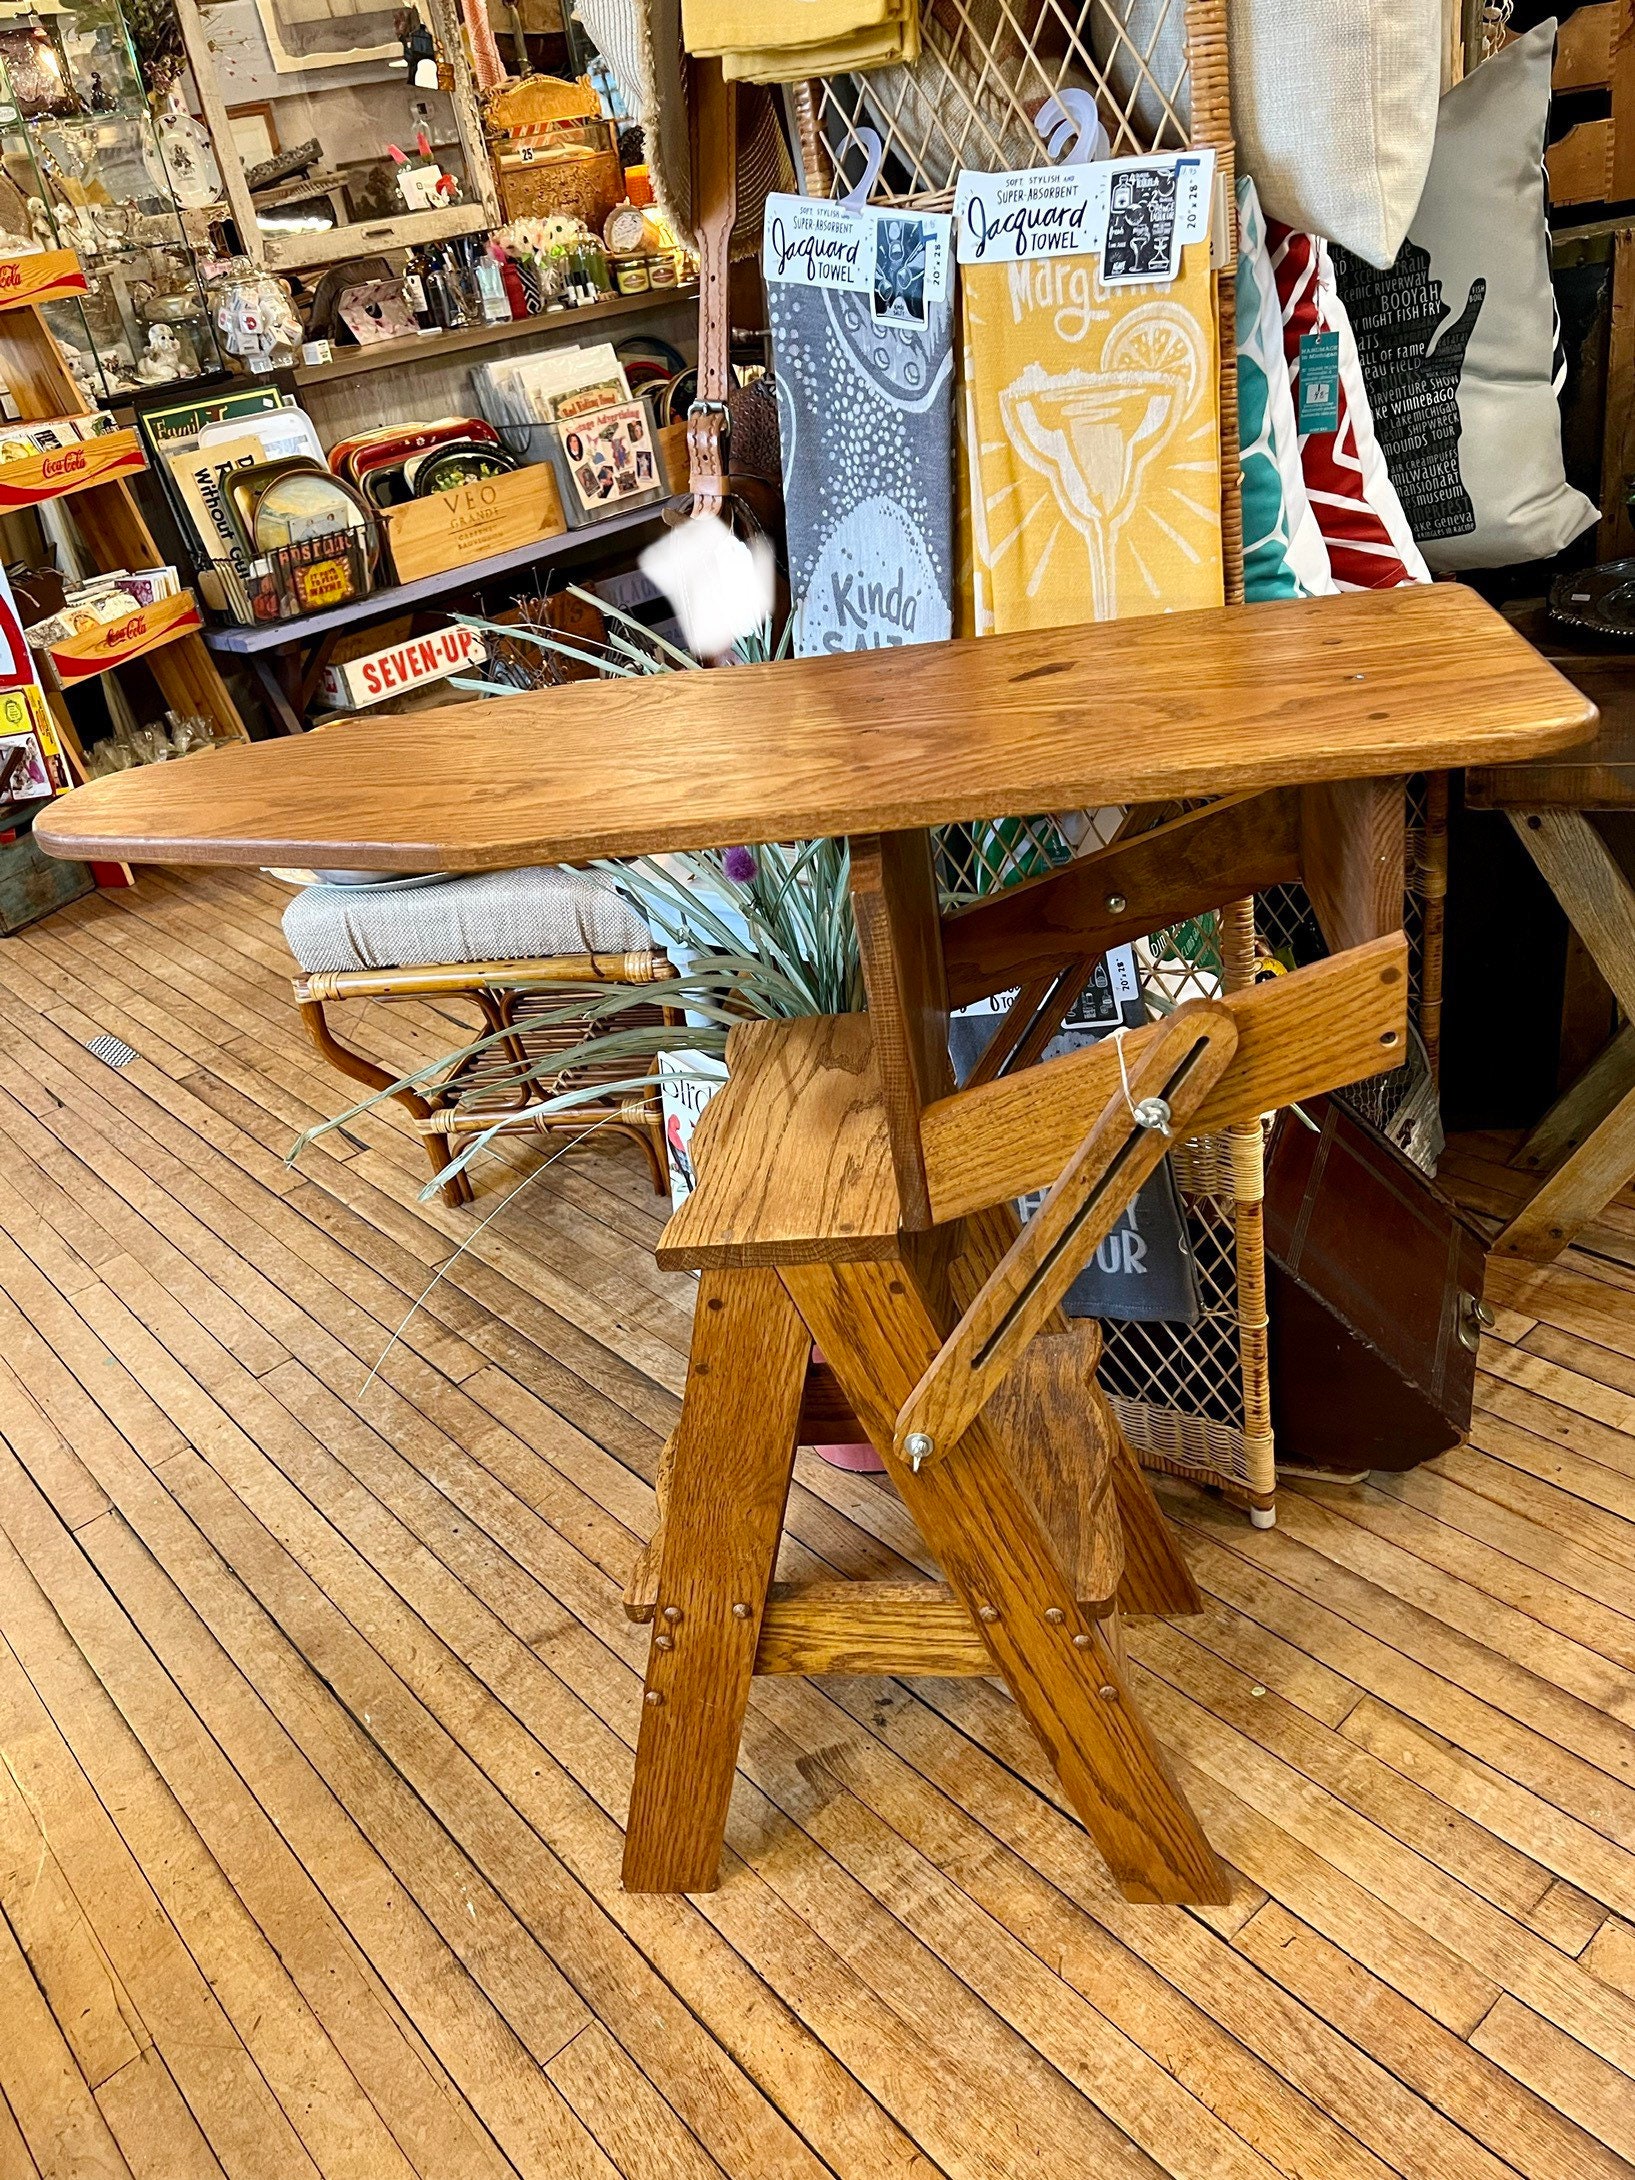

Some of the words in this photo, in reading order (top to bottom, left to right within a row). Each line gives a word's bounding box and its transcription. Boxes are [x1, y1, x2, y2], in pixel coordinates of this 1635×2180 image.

[522, 148, 533, 161] 25
[1029, 175, 1060, 185] STYLISH
[997, 185, 1079, 205] SUPER-ABSORBENT
[817, 206, 840, 219] STYLISH
[793, 216, 853, 234] SUPER-ABSORBENT
[967, 196, 1088, 258] Jacquard
[772, 217, 860, 281] Jacquard
[1031, 231, 1079, 252] TOWEL
[818, 262, 854, 283] TOWEL
[1396, 306, 1420, 323] FISH
[1423, 300, 1441, 316] FRY
[1380, 349, 1393, 362] OF
[1430, 375, 1459, 391] SHOW
[156, 410, 200, 439] Famil
[1431, 425, 1456, 441] TOUR
[42, 449, 87, 481] Coca-Cola
[194, 467, 235, 540] Without
[444, 485, 497, 514] VEO
[450, 507, 501, 529] GRANDE
[309, 580, 342, 597] WAYNE
[831, 566, 917, 634] Kinda
[105, 614, 147, 648] Coca-Cola
